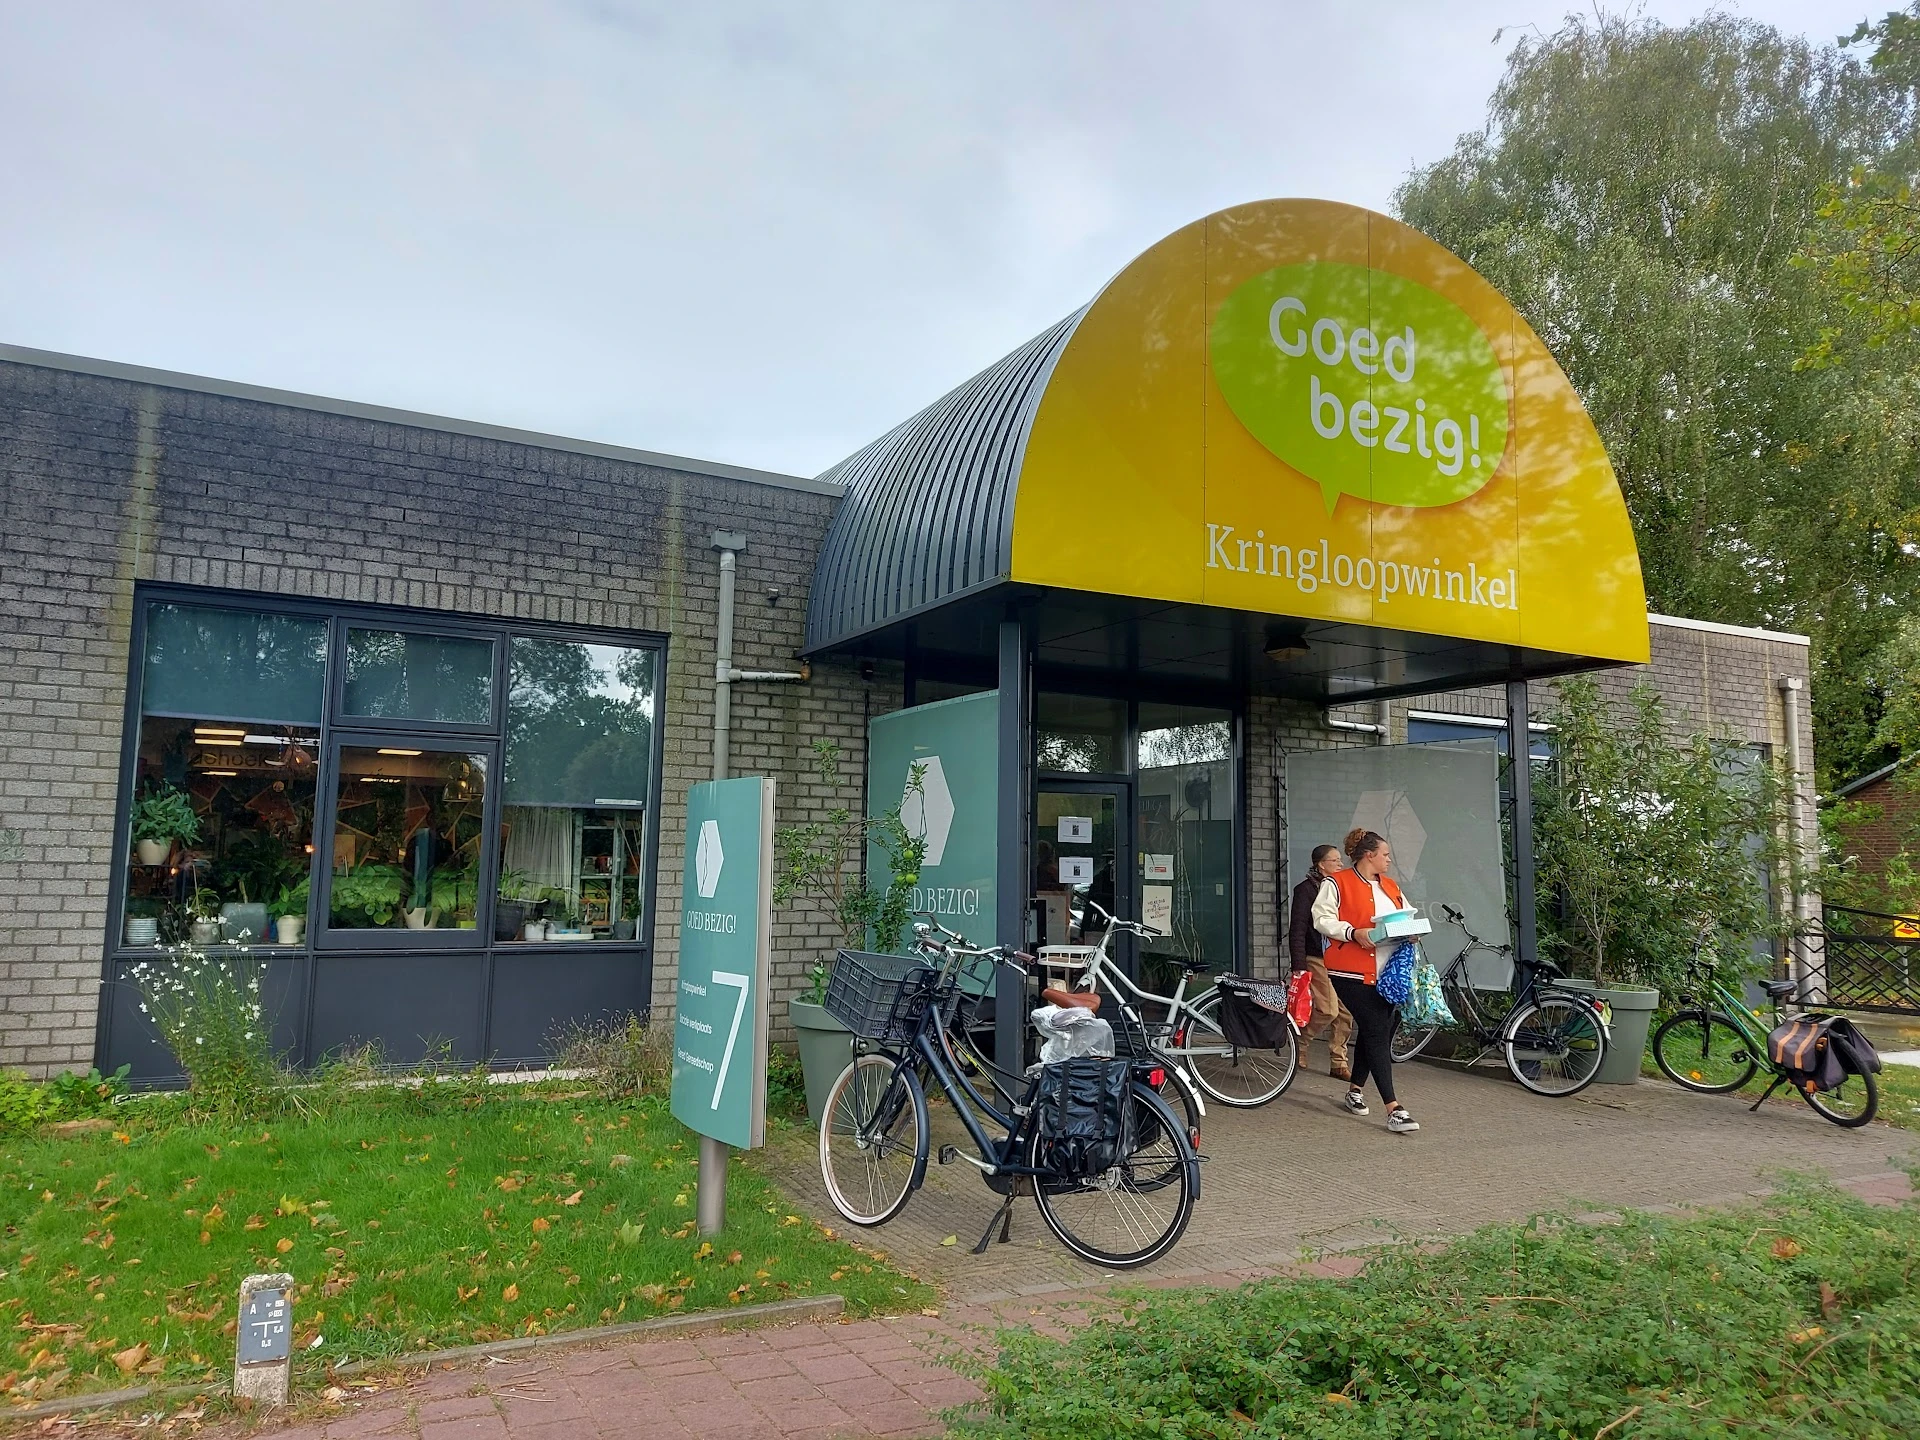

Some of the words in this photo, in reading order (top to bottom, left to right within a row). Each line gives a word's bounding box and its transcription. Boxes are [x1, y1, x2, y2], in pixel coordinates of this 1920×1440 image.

[1269, 296, 1415, 383] Goed
[1310, 374, 1481, 476] bezig!
[1206, 523, 1519, 610] Kringloopwinkel
[687, 910, 704, 930] GOED
[704, 912, 737, 934] BEZIG!
[926, 887, 979, 916] BEZIG!
[711, 970, 749, 1111] 7
[250, 1303, 257, 1315] A
